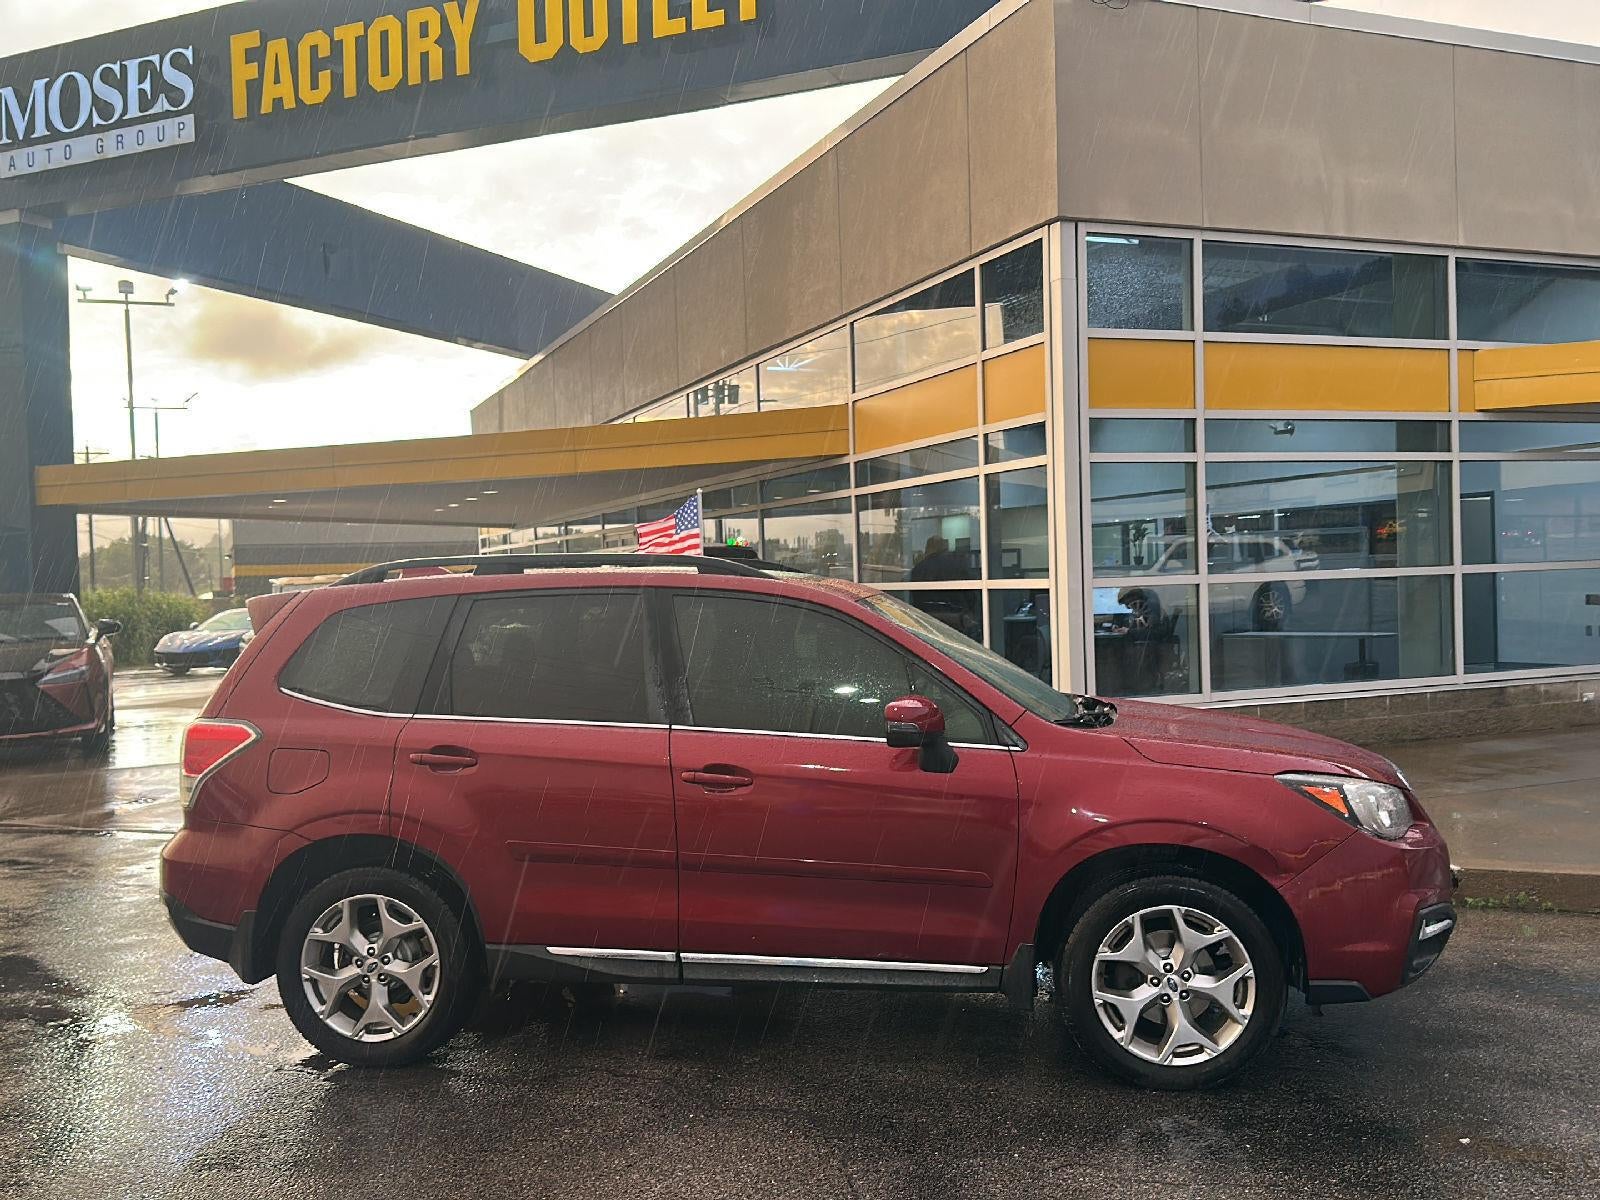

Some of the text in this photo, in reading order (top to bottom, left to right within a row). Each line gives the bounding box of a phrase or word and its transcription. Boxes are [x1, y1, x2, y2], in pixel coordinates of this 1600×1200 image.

[0, 45, 194, 144] MOSES
[230, 0, 480, 119] FACTORY
[8, 121, 186, 172] AUTO GROUP
